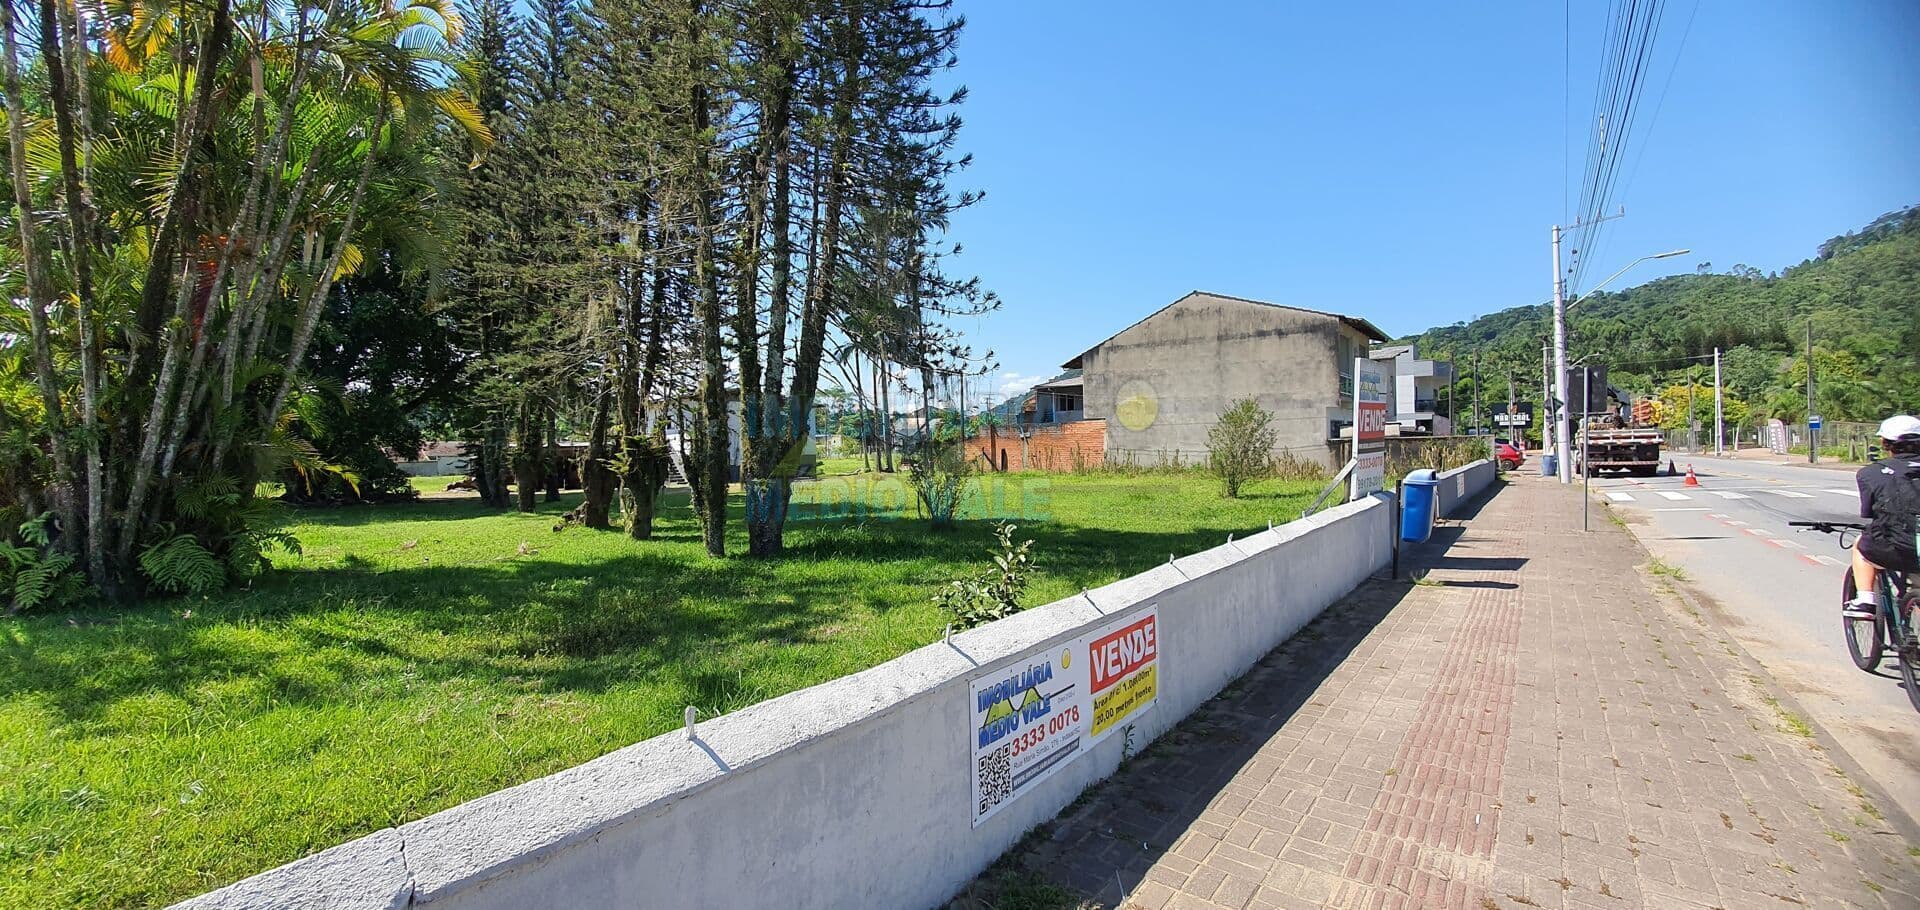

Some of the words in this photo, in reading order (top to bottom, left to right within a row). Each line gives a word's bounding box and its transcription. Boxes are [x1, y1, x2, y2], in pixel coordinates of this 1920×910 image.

[1359, 410, 1386, 432] VENDE
[1494, 414, 1531, 422] MARCHAL
[1092, 622, 1156, 683] VENDE
[978, 661, 1053, 713] IMOBILIÁRIA
[1022, 693, 1051, 725] VALE
[1011, 723, 1045, 757] 3333
[1049, 705, 1080, 735] 0078
